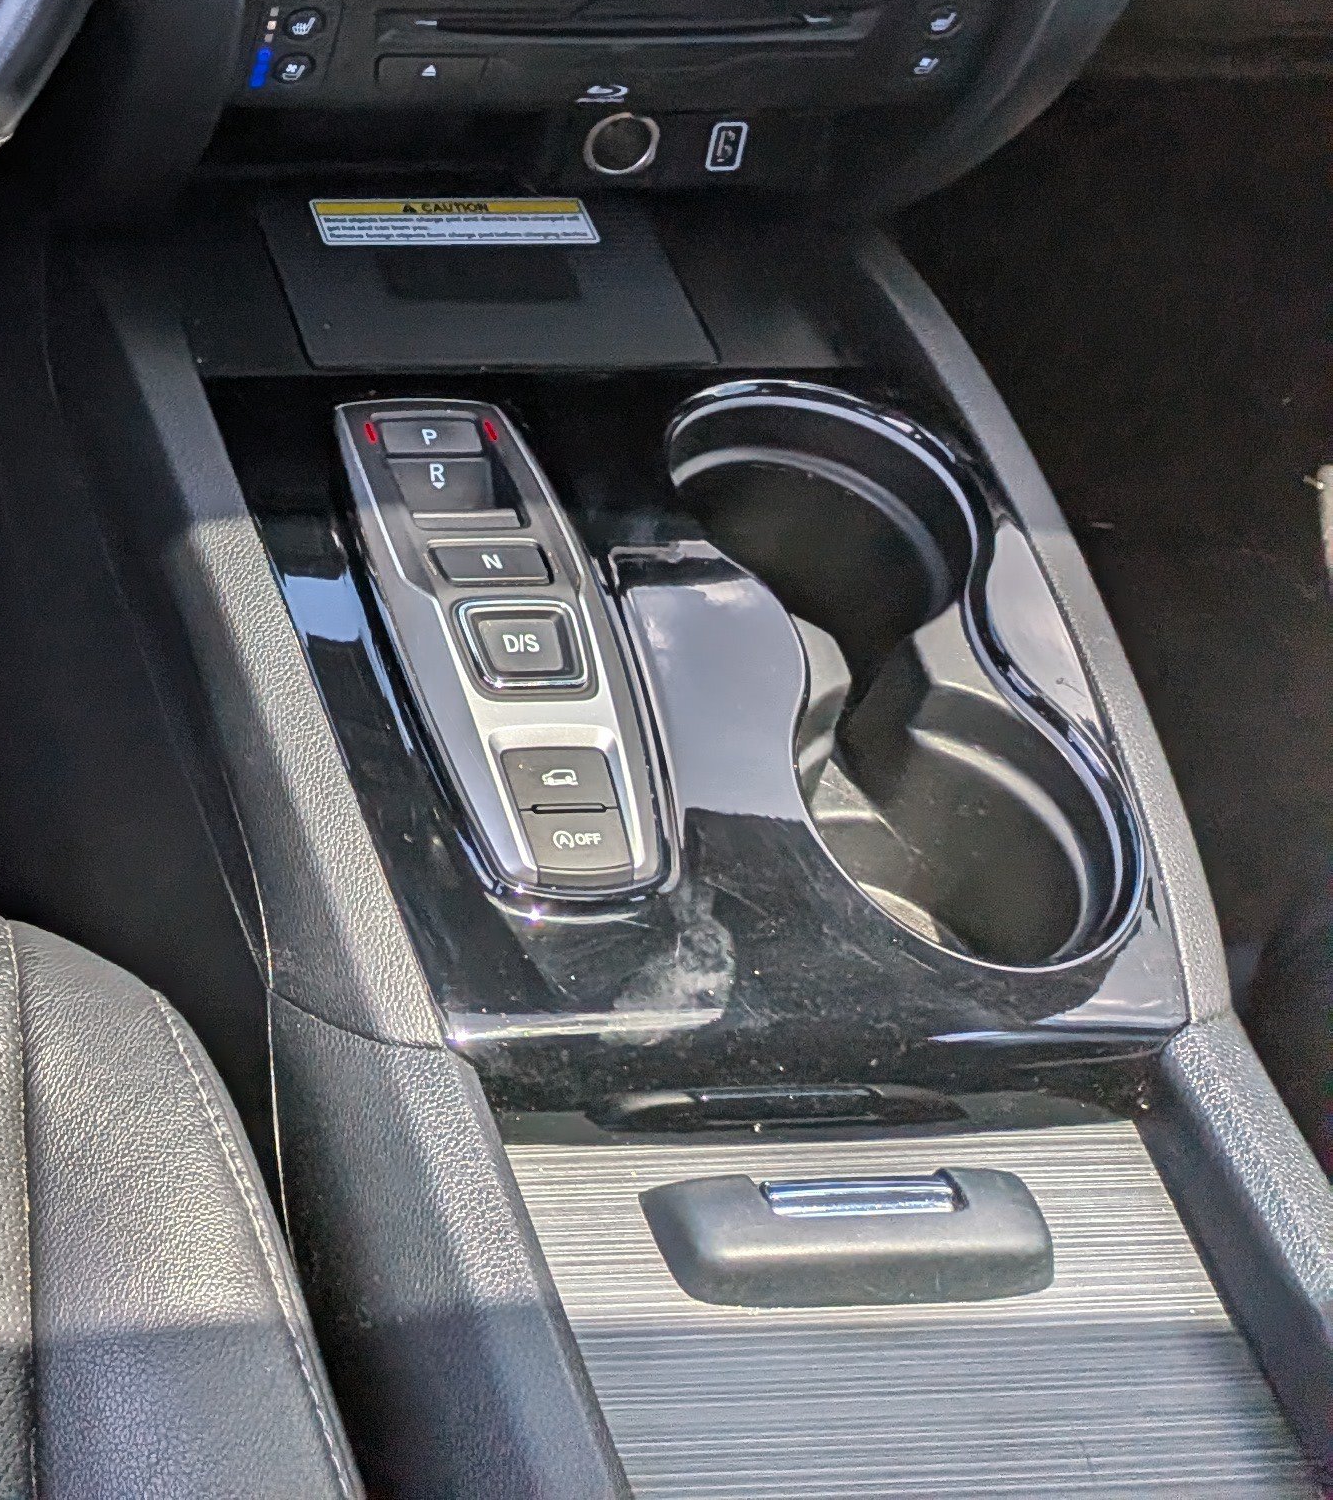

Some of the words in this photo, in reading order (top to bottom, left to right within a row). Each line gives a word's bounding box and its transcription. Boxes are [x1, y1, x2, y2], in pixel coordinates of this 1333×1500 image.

[421, 202, 488, 213] CAUTION
[420, 427, 437, 445] P
[429, 464, 445, 482] R
[481, 554, 502, 570] N
[502, 634, 540, 654] D/S
[574, 831, 601, 846] OFF
